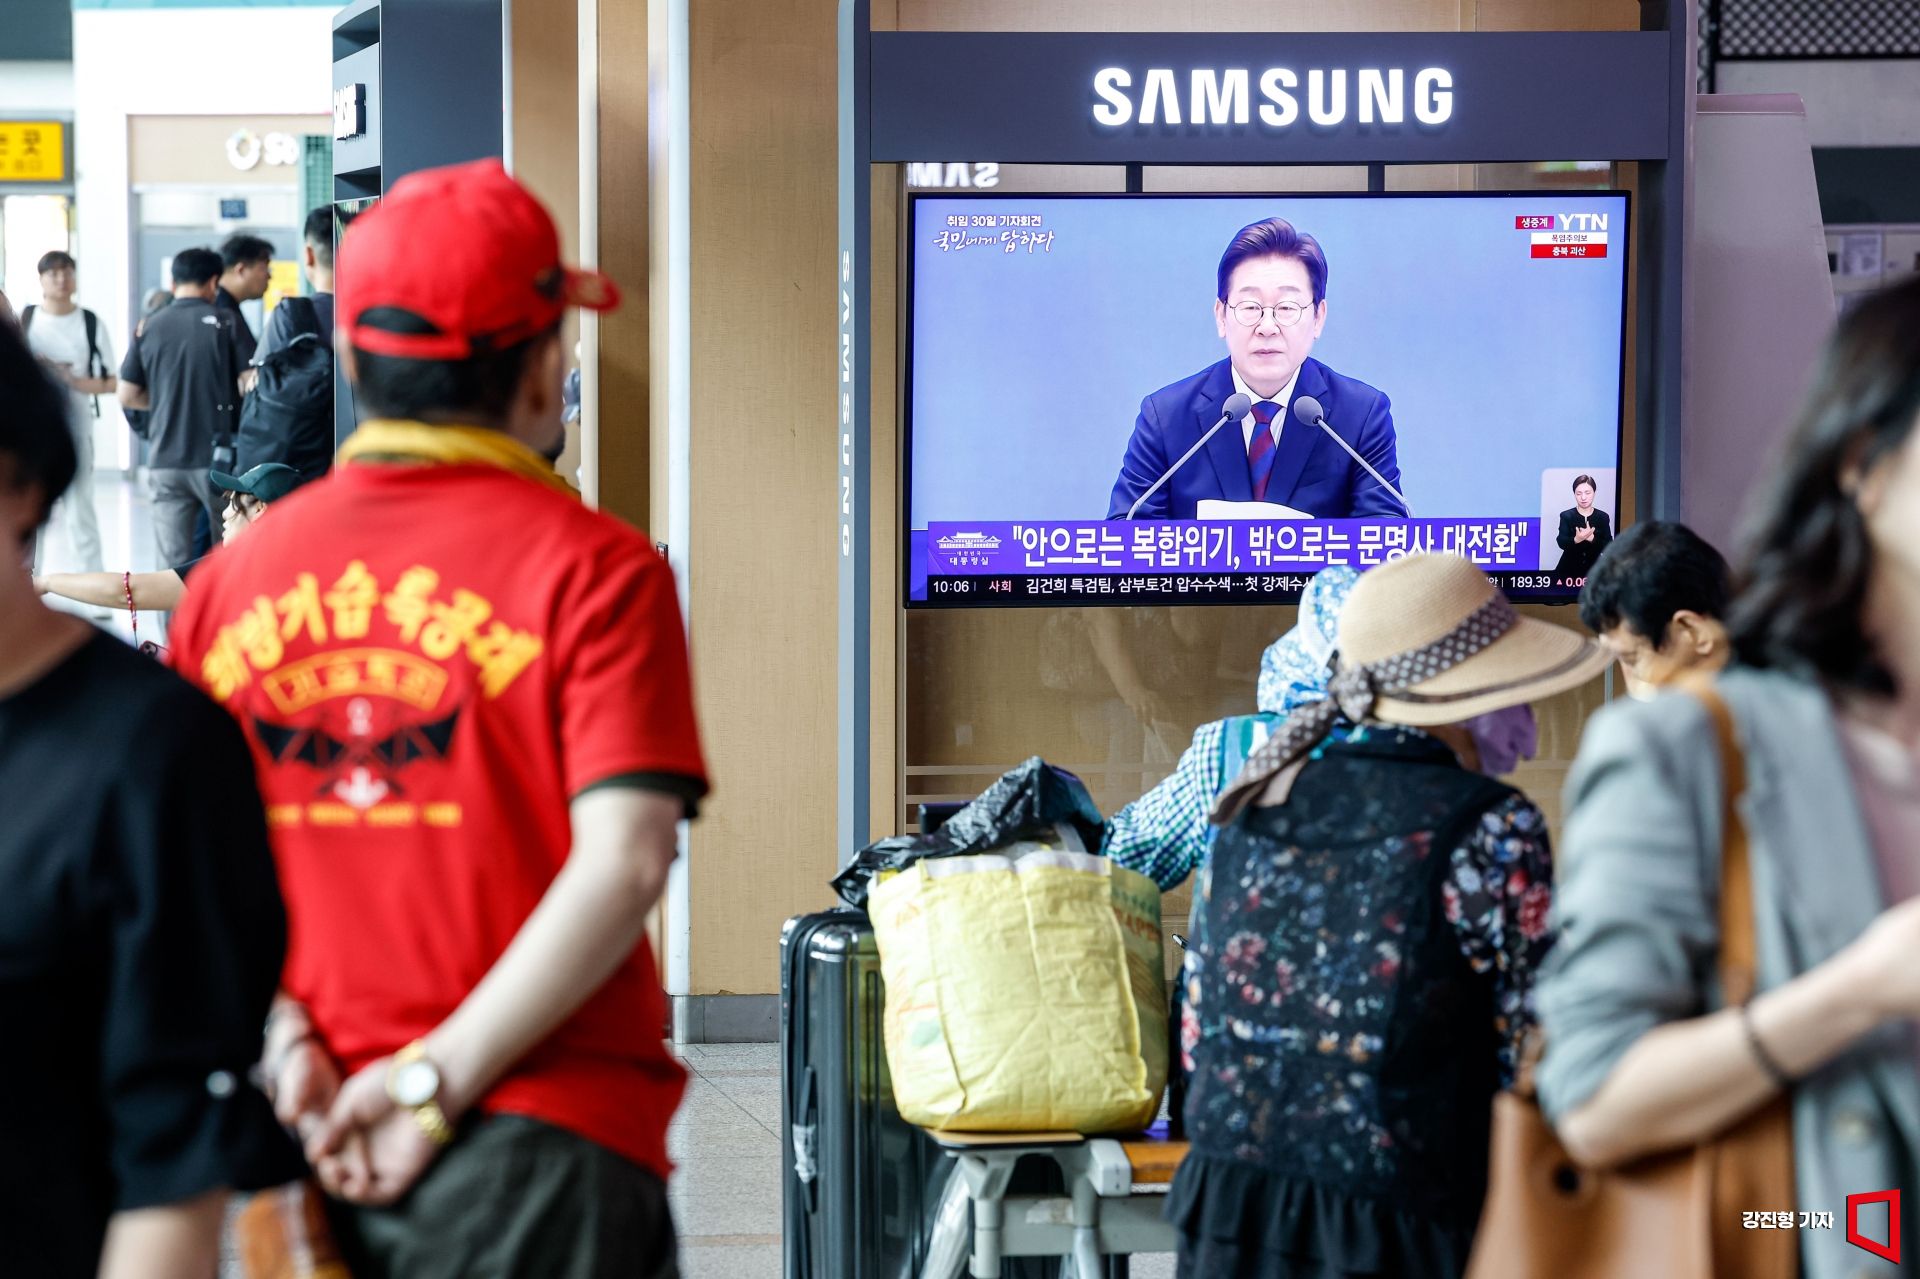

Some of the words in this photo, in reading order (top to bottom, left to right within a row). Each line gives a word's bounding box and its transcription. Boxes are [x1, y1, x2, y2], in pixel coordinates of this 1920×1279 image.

[1092, 67, 1454, 126] SAMSUNG
[947, 215, 968, 227] 취임
[971, 215, 997, 227] 30일
[1000, 215, 1041, 227] 기자회견
[1521, 217, 1548, 228] 생중계
[1559, 213, 1608, 231] YTN
[933, 230, 997, 252] 국민에게
[1000, 229, 1055, 253] 답하다
[1552, 234, 1588, 242] 폭염주의보
[1552, 246, 1568, 256] 충북
[1570, 246, 1586, 256] 괴산
[842, 249, 850, 556] SAMSUNG
[1012, 525, 1125, 567] "안으로는
[1131, 525, 1241, 570] 복합위기,
[1248, 525, 1351, 566] 밖으로는
[949, 556, 989, 566] 대통령실
[933, 580, 970, 593] 10:06
[988, 579, 1012, 593] 사회
[1026, 578, 1067, 593] 김건희
[1070, 578, 1115, 594] 특검팀,
[1118, 577, 1173, 593] 삼부토건
[1510, 576, 1551, 588] 189.39
